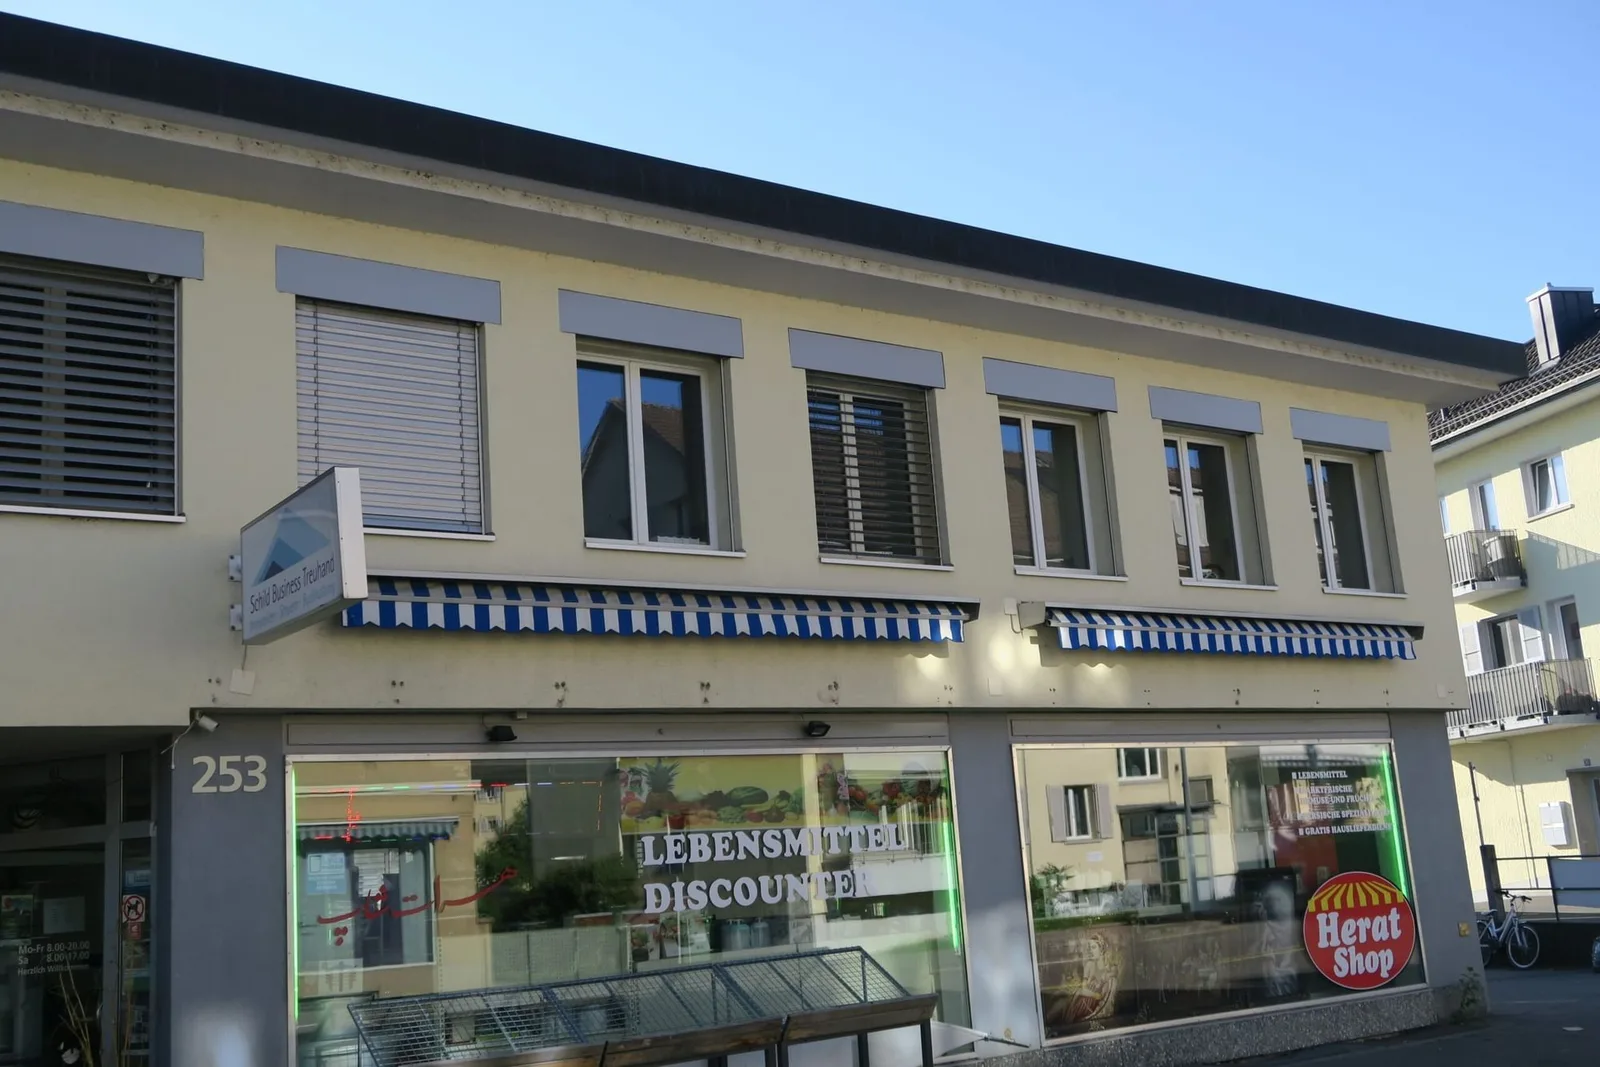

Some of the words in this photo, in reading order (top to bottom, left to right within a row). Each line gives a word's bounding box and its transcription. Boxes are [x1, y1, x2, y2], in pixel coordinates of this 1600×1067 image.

[250, 586, 271, 614] Schild
[272, 576, 301, 604] Business
[302, 555, 335, 588] Treuhand
[192, 755, 268, 794] 253
[1298, 770, 1348, 779] LEBENSMITTEL
[641, 823, 904, 866] LEBENSMITTEL
[1305, 826, 1330, 836] GRATIS
[643, 868, 878, 914] DISCOUNTER
[1317, 907, 1402, 949] Herat
[18, 944, 45, 955] Mo-Fr
[18, 956, 29, 965] Sa
[1333, 946, 1394, 978] Shop
[17, 966, 46, 977] Herzlich
